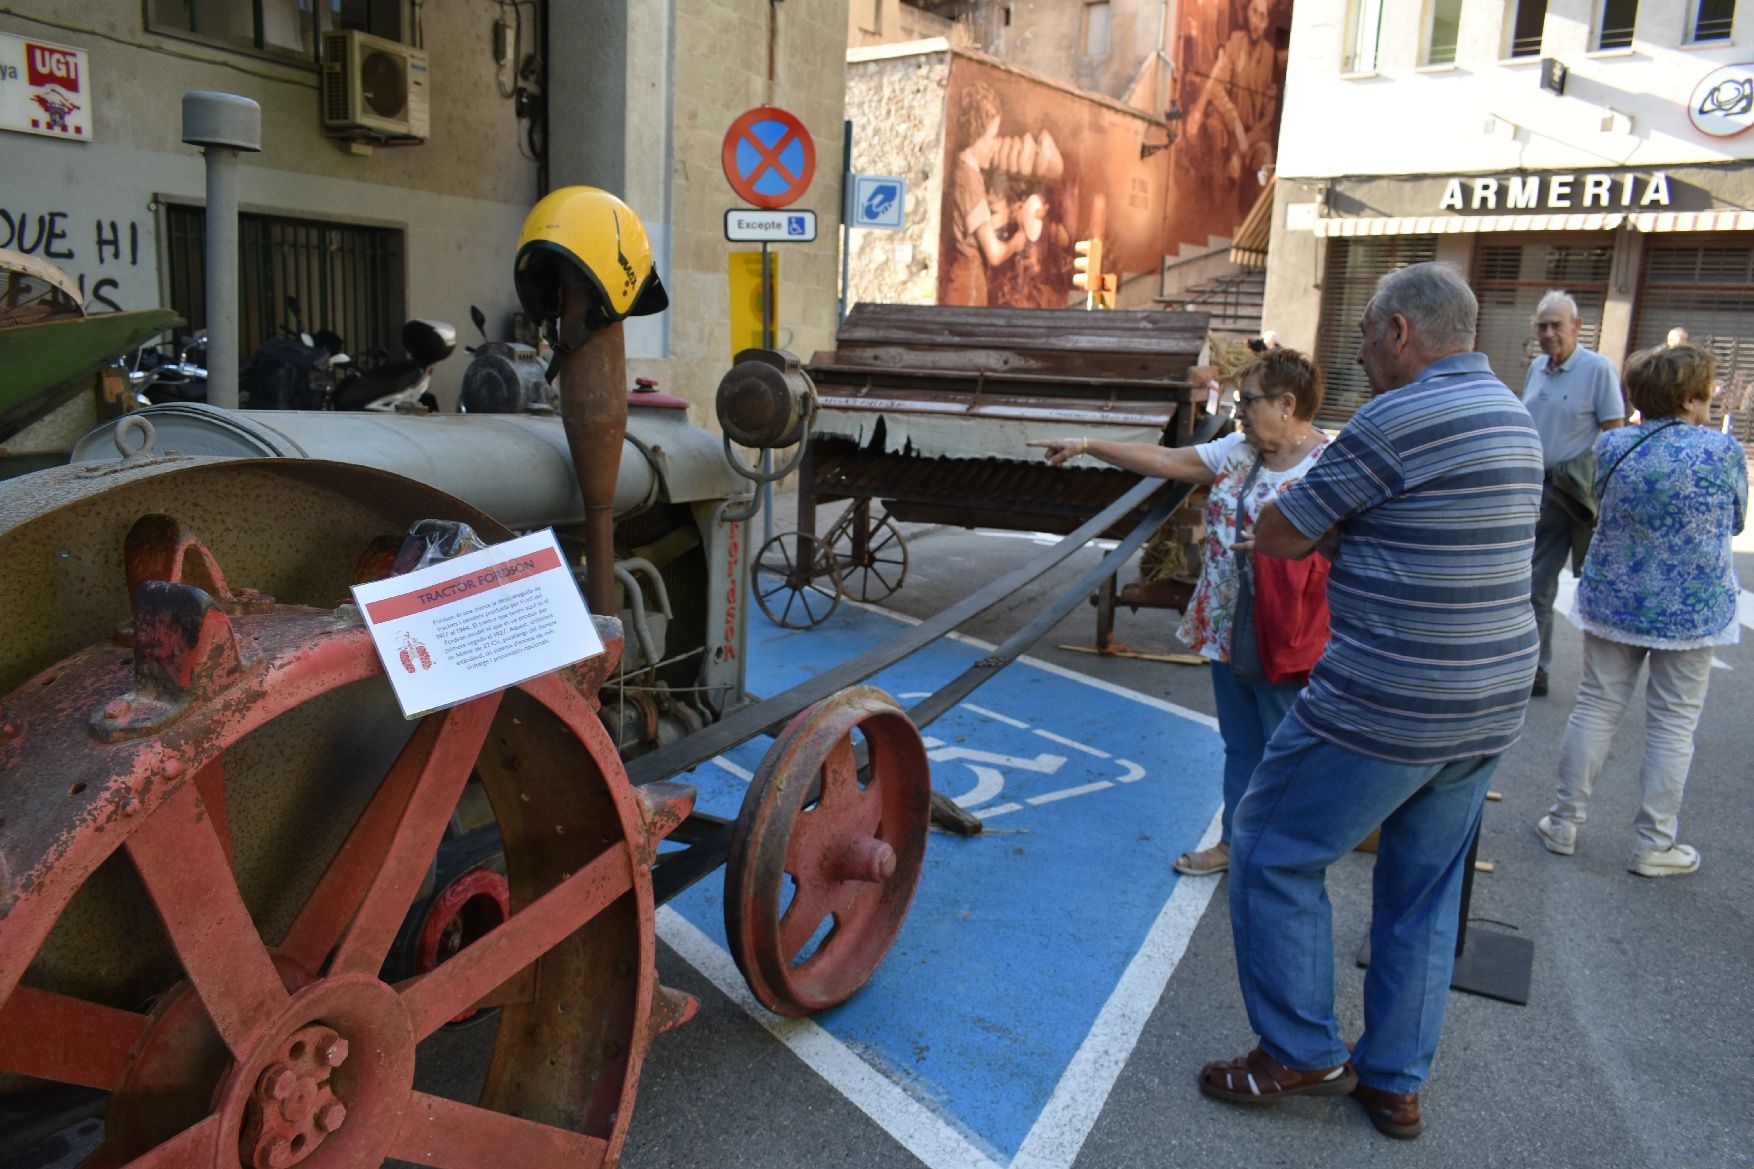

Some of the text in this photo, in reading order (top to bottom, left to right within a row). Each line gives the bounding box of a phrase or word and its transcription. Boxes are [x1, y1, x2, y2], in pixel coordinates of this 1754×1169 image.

[36, 49, 78, 80] UGT
[1440, 172, 1672, 210] ARMERIA
[96, 219, 138, 266] HI
[737, 219, 783, 231] Excepte
[417, 560, 534, 603] TRACTOR FORDSON
